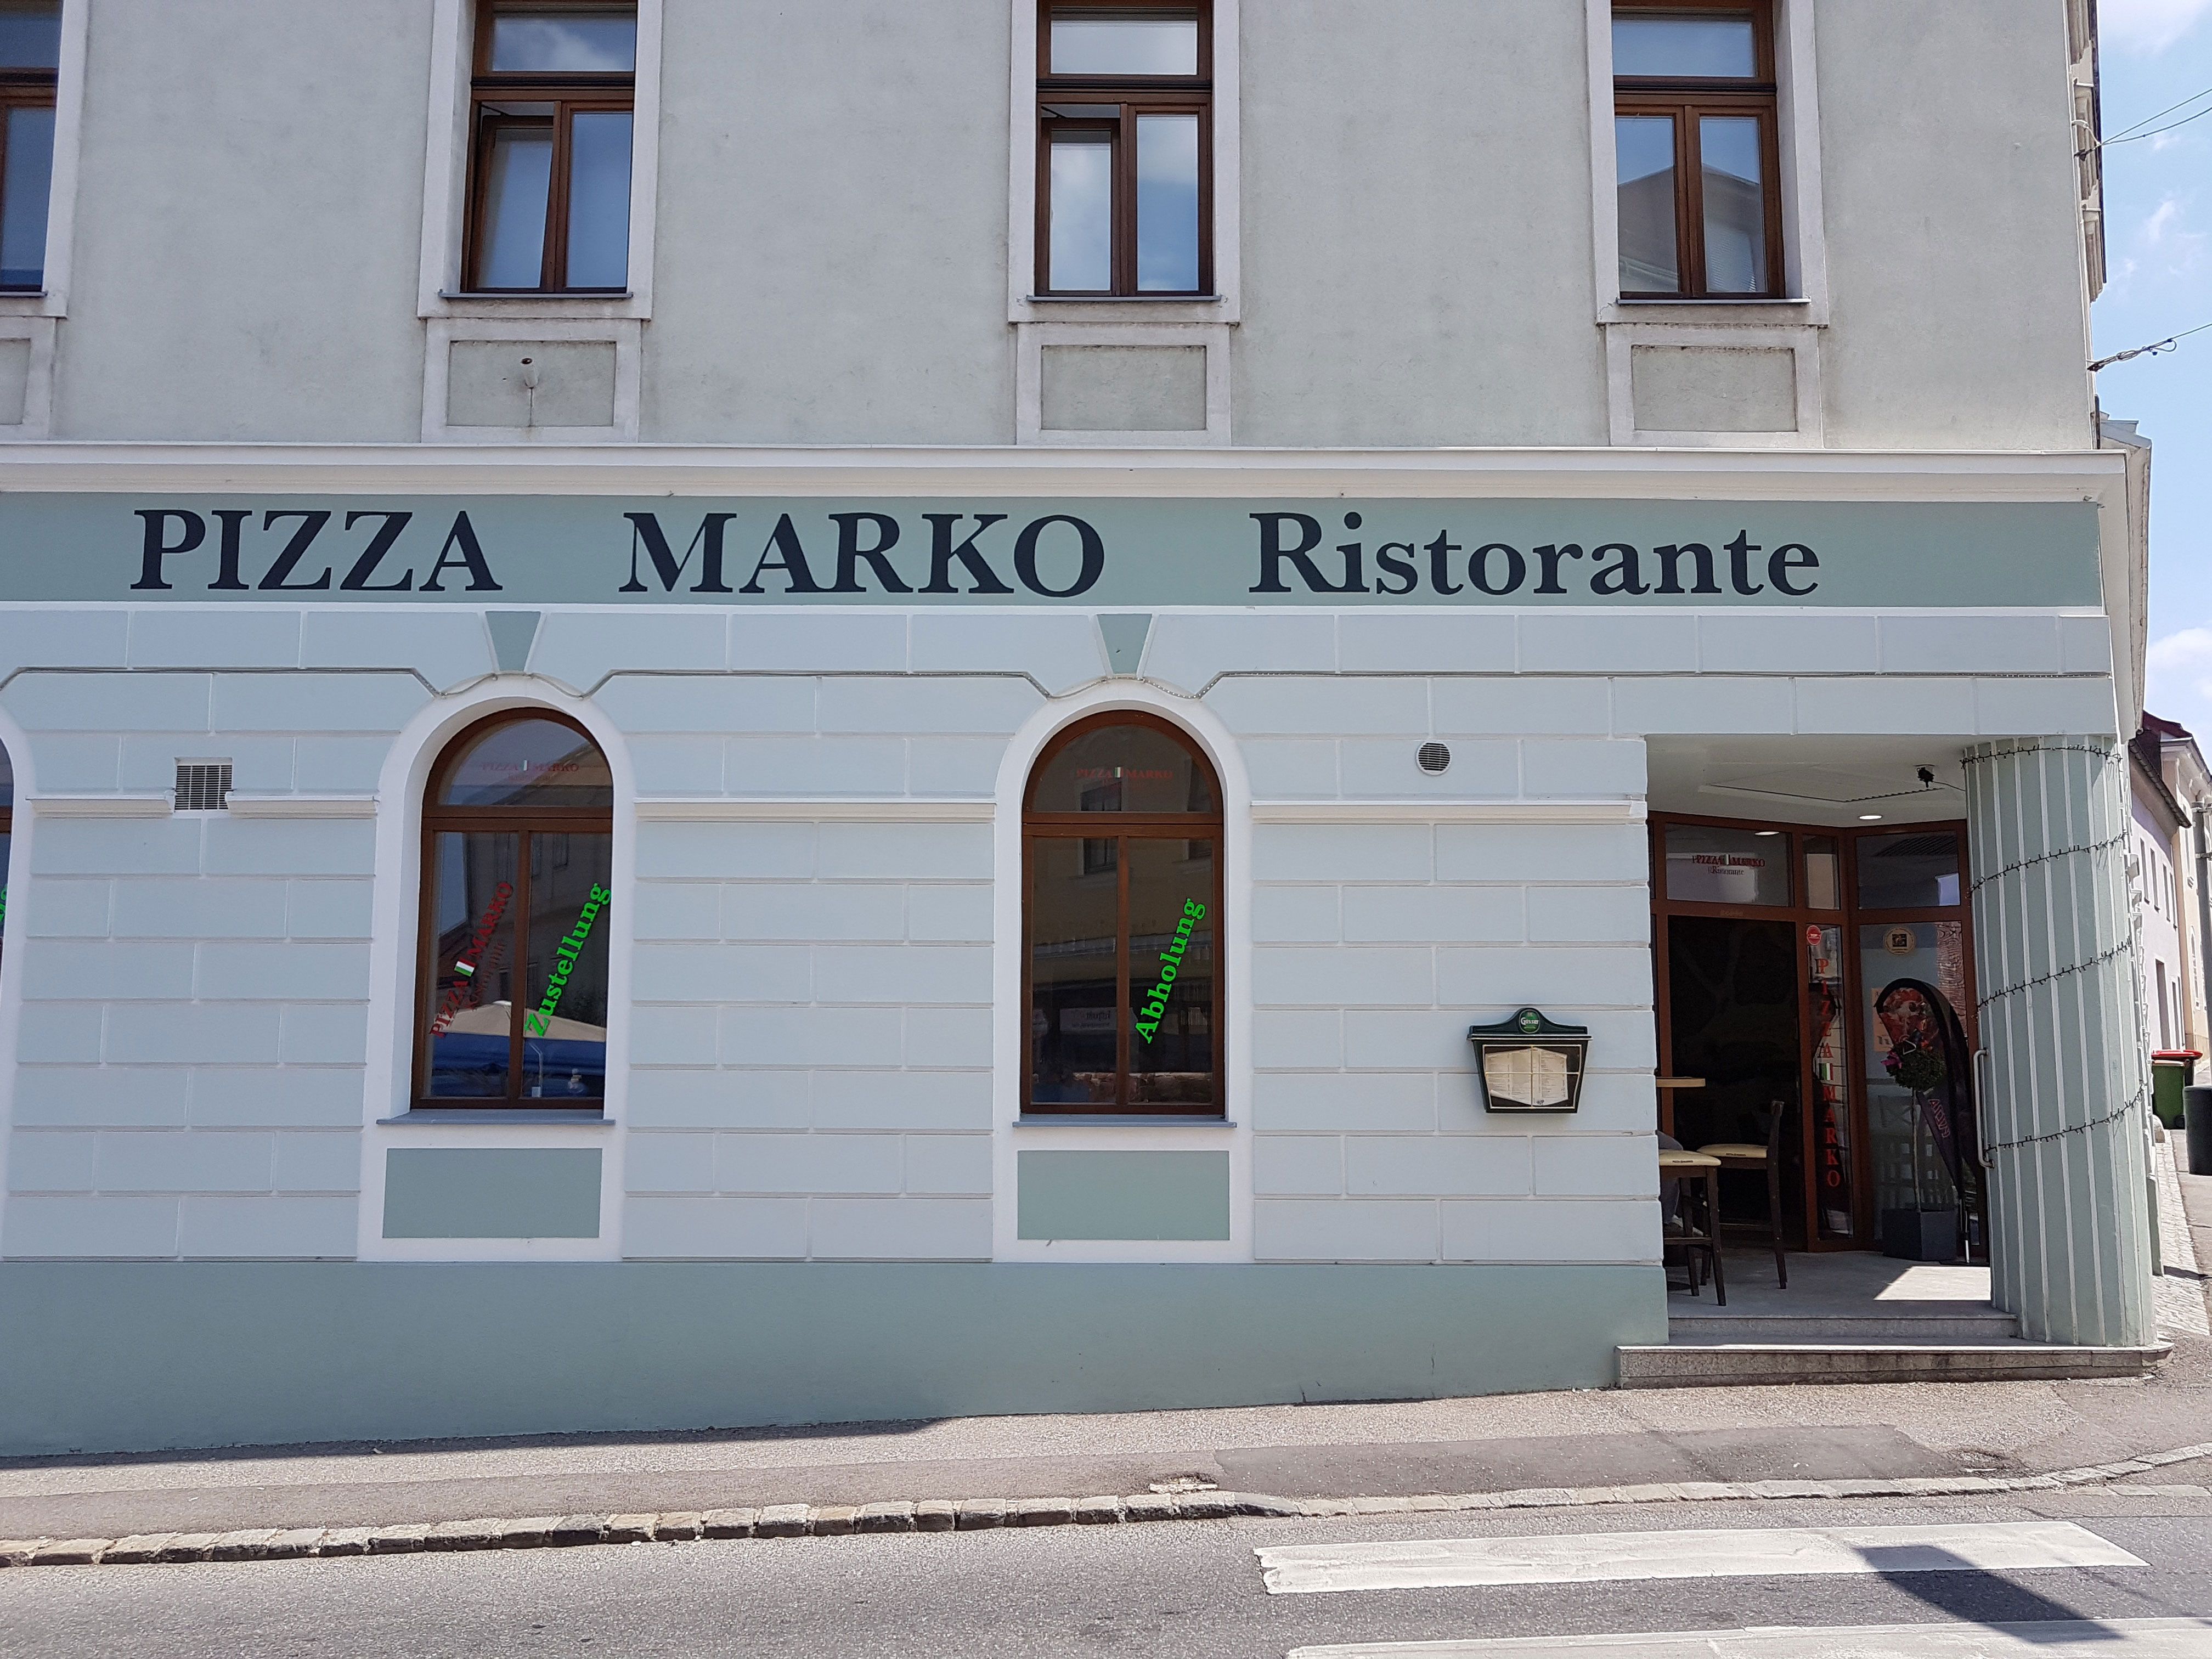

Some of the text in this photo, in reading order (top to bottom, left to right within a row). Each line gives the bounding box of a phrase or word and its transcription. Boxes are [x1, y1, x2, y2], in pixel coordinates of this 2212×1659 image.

[130, 509, 1820, 598] PIZZA MARKO Ristorante
[1076, 769, 1173, 780] PIZZA MARKO
[1696, 855, 1765, 867] PIZZA MARKO
[429, 882, 513, 1038] PIZZA MARKO
[524, 883, 611, 1037] Zustellung
[1136, 898, 1207, 1044] Abholung
[1816, 958, 1841, 1187] PIZZA MARKO
